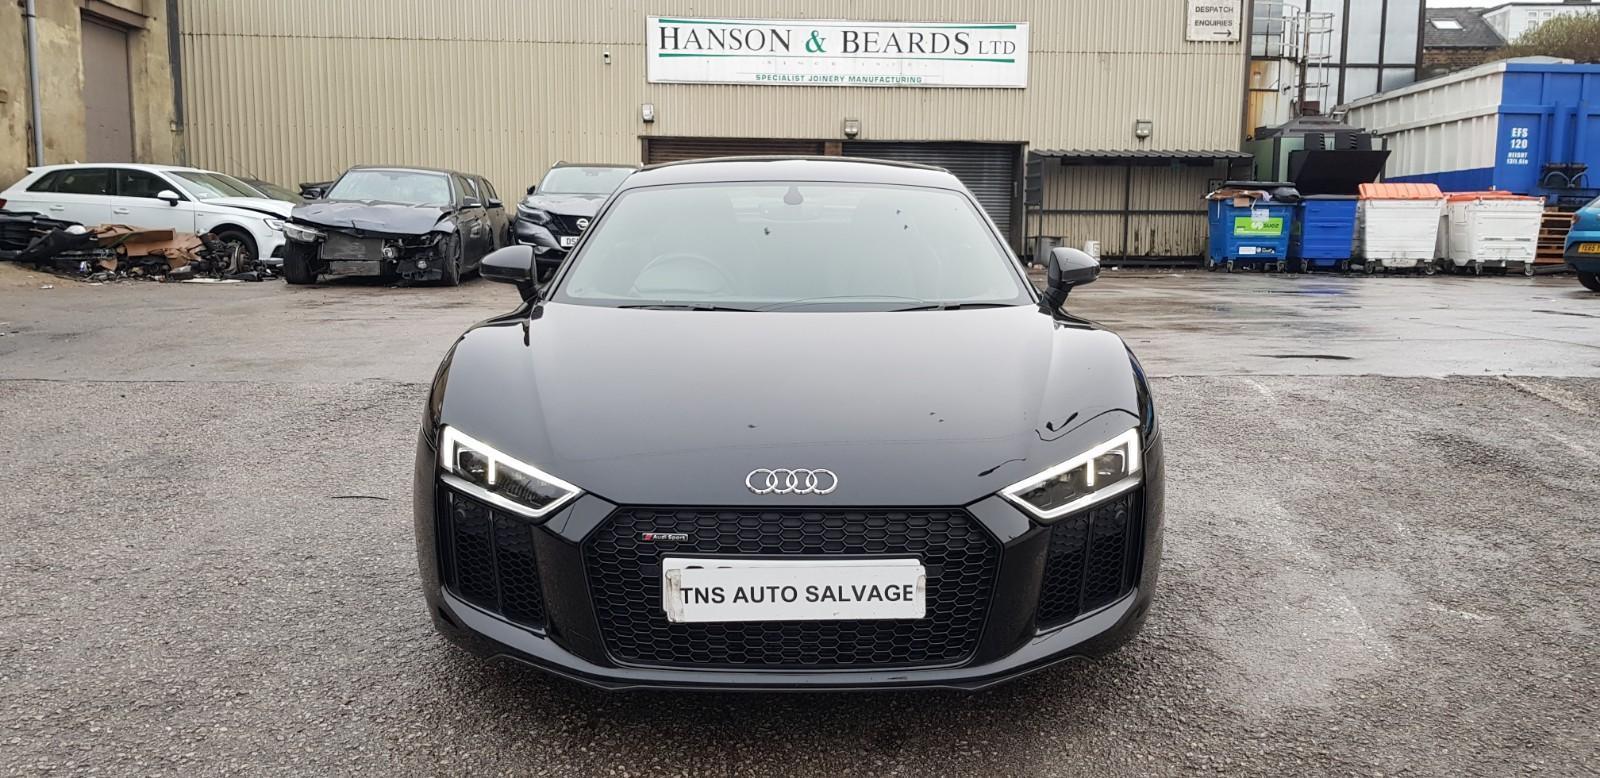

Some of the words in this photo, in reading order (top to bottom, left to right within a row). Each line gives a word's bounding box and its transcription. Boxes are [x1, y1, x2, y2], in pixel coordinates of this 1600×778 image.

[659, 26, 792, 52] HANSON
[805, 29, 827, 53] &
[841, 30, 970, 55] BEARDS
[978, 40, 1016, 55] LTD
[755, 74, 805, 82] SPECIALIST
[808, 75, 845, 83] JOINERY
[848, 75, 923, 84] MANUFACTURING
[1511, 127, 1529, 138] EFS
[1511, 138, 1528, 149] 120
[680, 586, 725, 604] TNS
[732, 585, 798, 603] AUTO
[805, 584, 913, 602] SALVAGE
